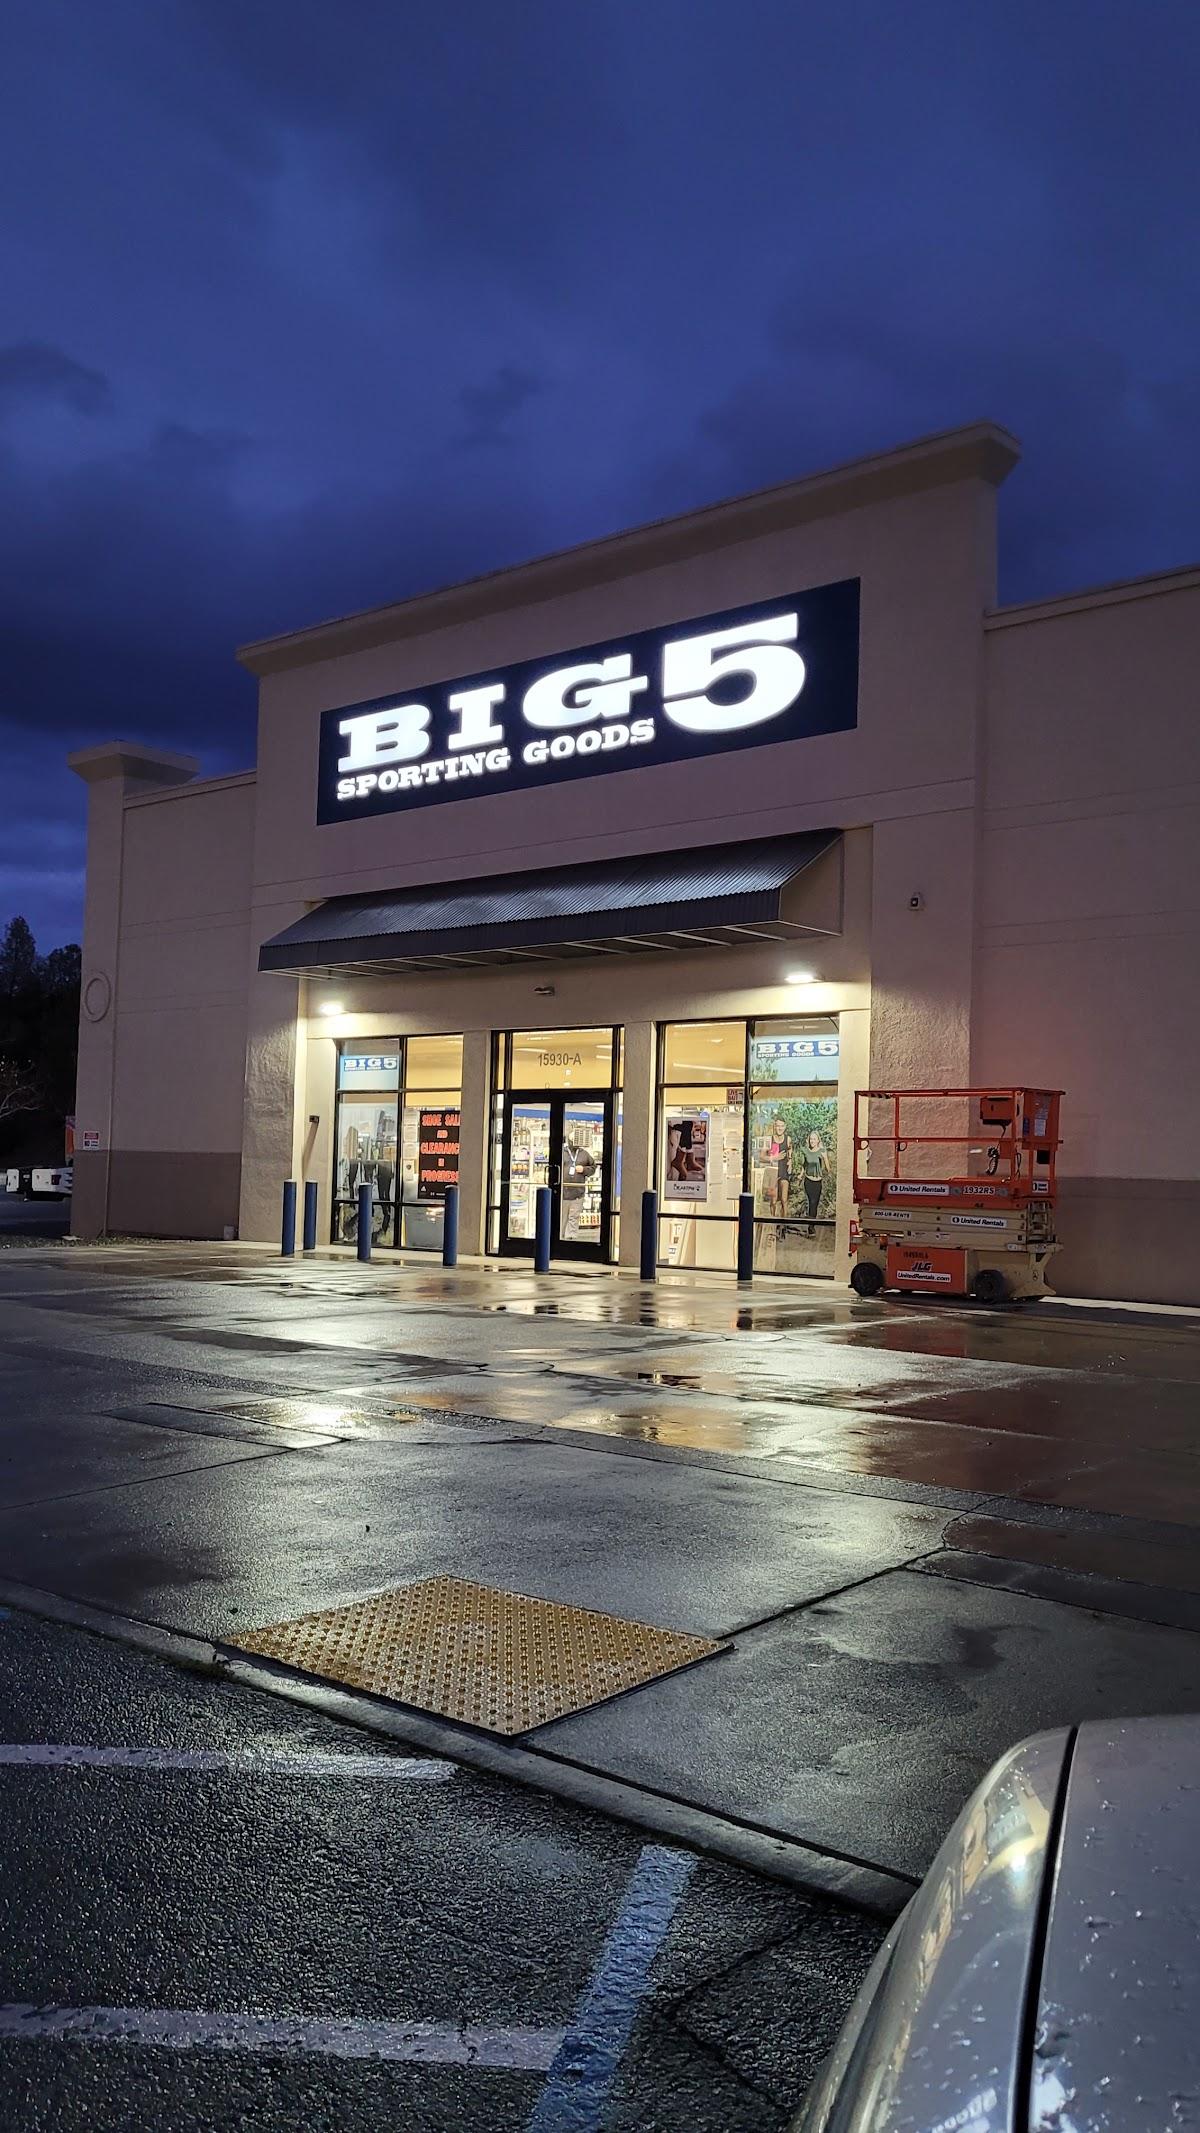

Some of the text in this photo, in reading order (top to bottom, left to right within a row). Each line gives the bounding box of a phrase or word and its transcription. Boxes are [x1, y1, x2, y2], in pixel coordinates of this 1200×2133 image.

[338, 612, 806, 772] BIG 5
[337, 718, 656, 800] SPORTING GOODS
[758, 1041, 838, 1056] BIG 5
[384, 1057, 397, 1069] 5
[538, 1053, 582, 1067] 15930-A
[420, 1142, 460, 1155] CLEARANC
[960, 1217, 1005, 1227] United Rentals
[911, 1261, 933, 1272] JLG
